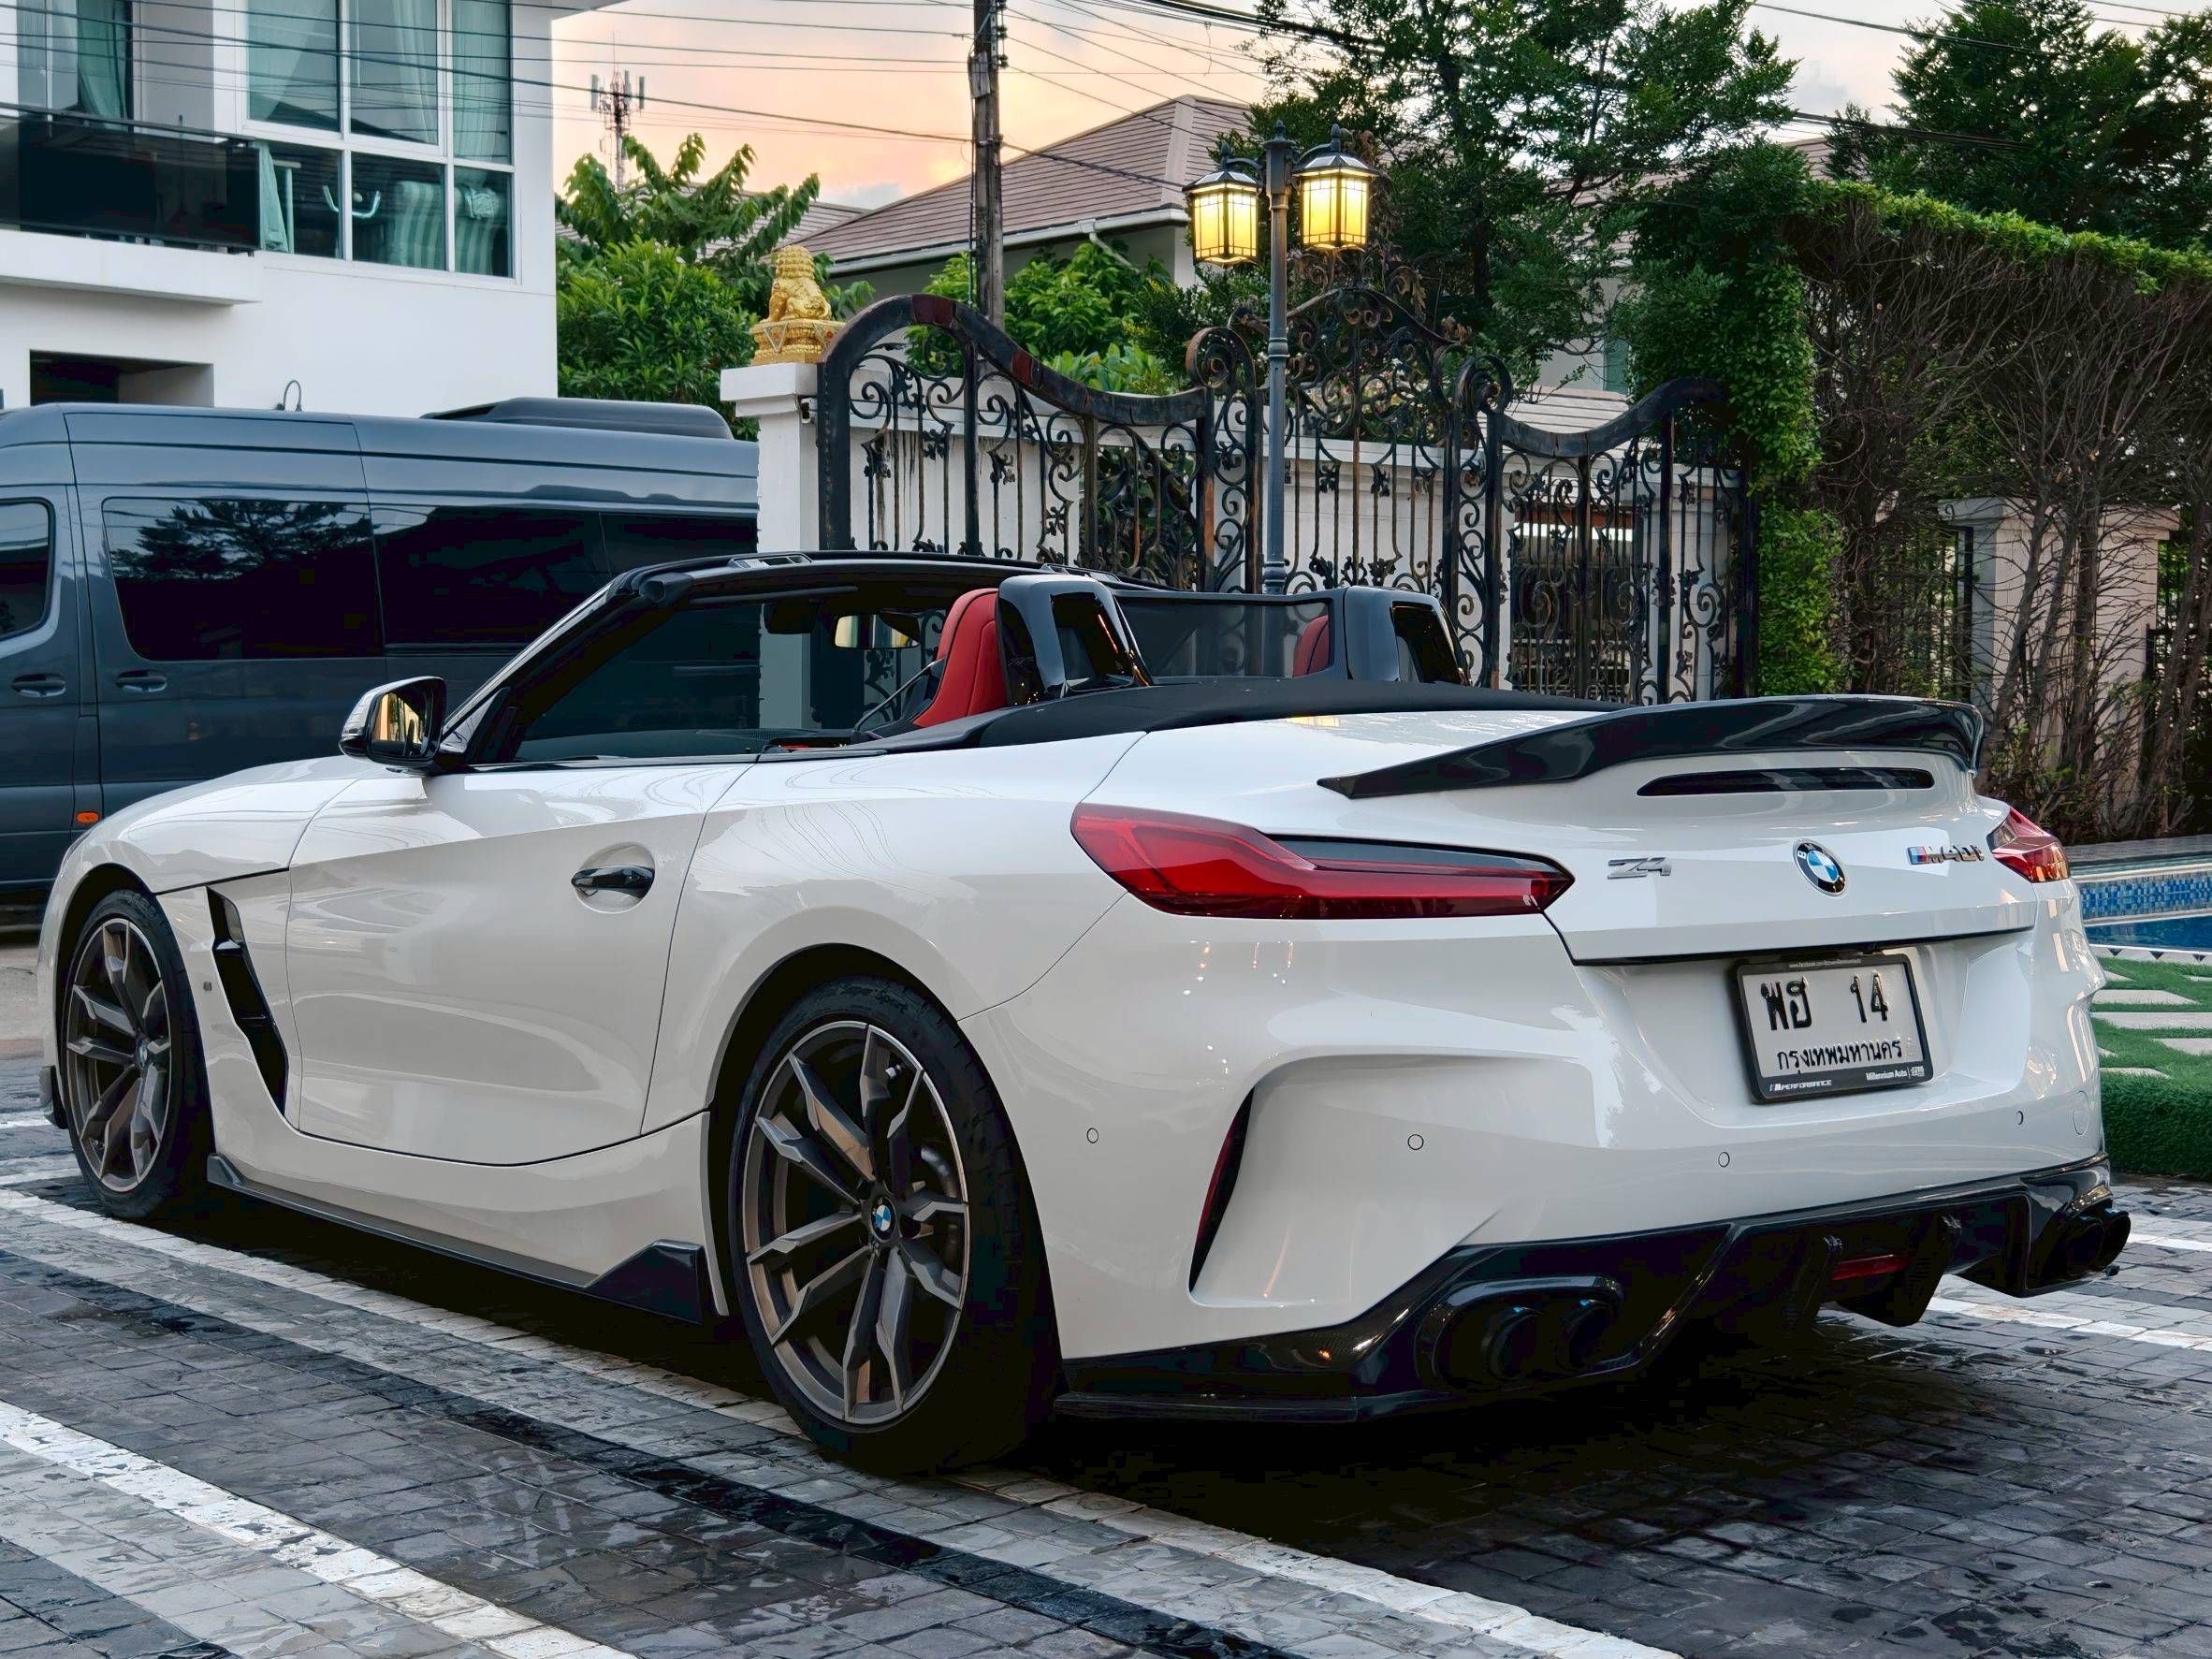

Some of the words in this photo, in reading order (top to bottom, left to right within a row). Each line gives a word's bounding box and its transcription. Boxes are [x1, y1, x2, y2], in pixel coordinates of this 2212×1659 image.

[1608, 857, 1671, 880] Z4
[1850, 972, 1888, 1023] 14
[1777, 1040, 1902, 1074] กรุงเทพมหานคร
